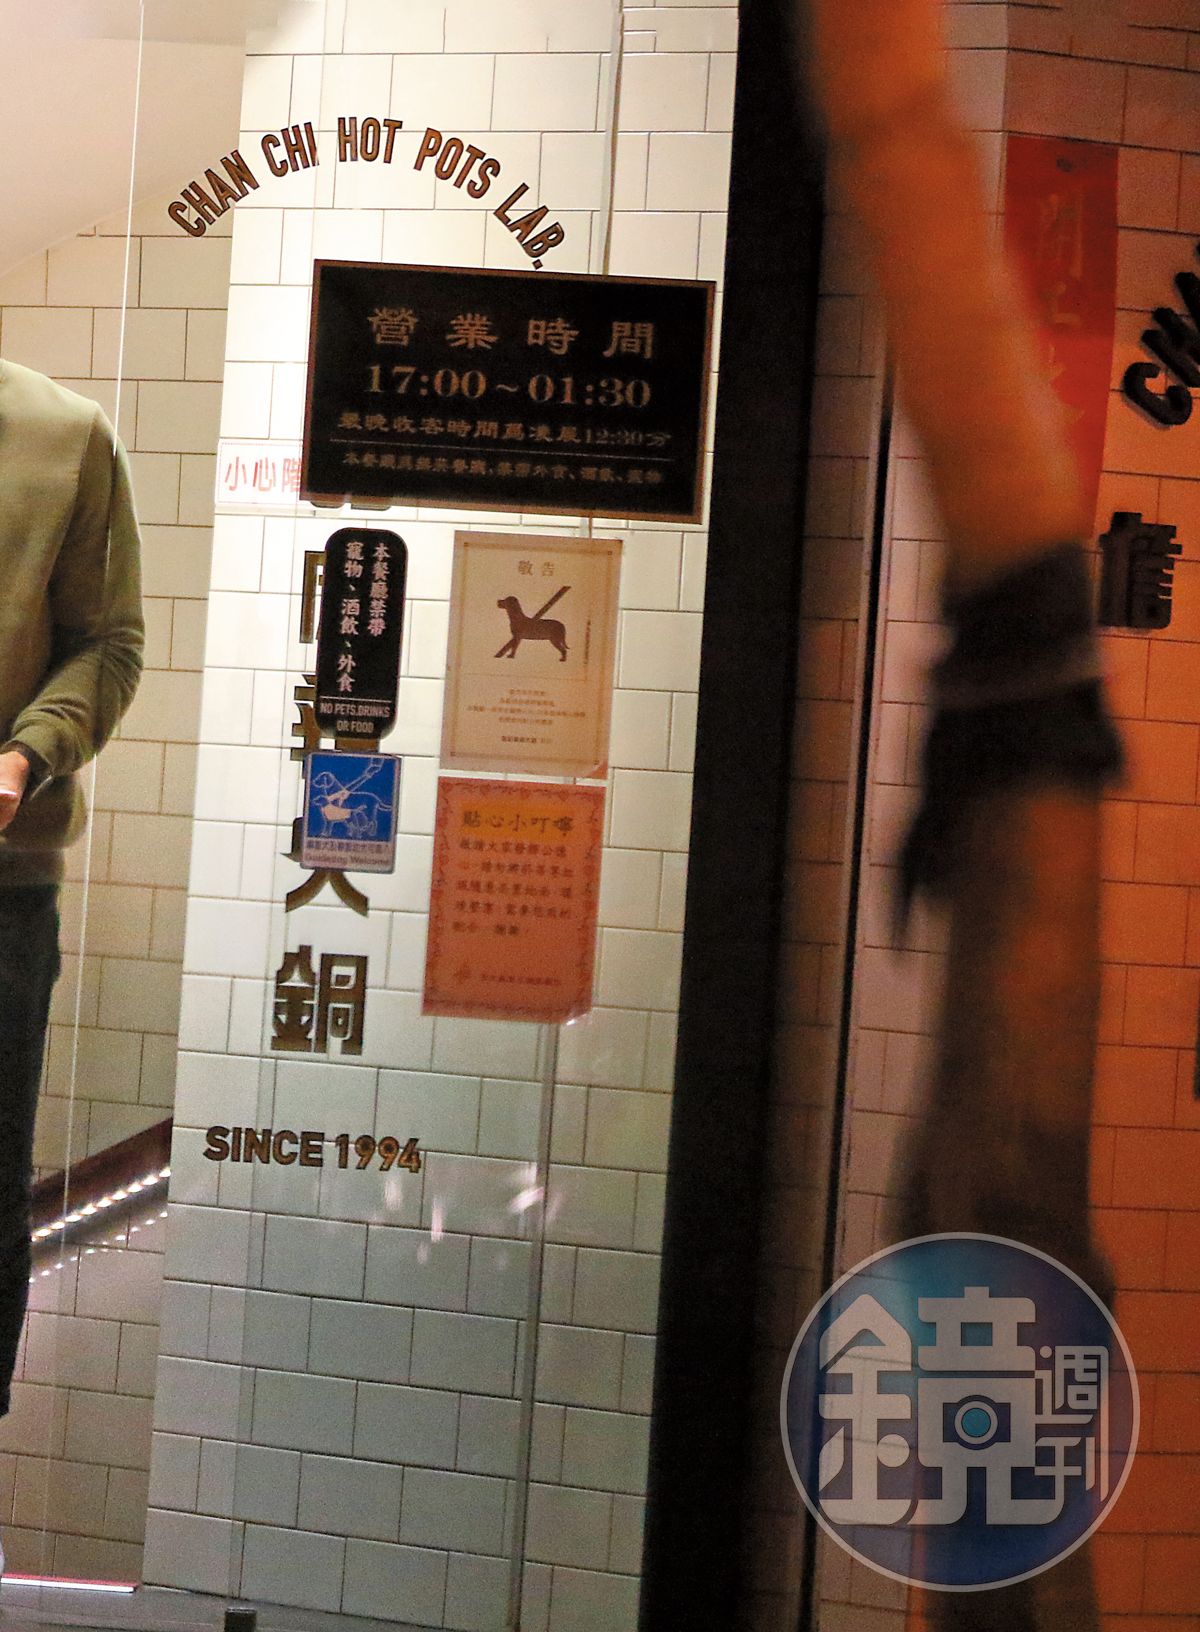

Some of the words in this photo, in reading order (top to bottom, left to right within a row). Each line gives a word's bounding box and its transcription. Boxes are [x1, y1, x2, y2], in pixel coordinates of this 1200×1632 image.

[168, 149, 259, 237] CHAN
[261, 121, 320, 178] CHI
[337, 116, 403, 164] HOT
[413, 127, 501, 199] POTS
[493, 182, 565, 270] LAB.
[368, 307, 655, 360] 營業時間
[320, 702, 333, 714] NO
[336, 720, 349, 732] OR
[351, 720, 375, 733] FOOD
[203, 1125, 325, 1168] SINCE
[336, 1133, 422, 1174] 1994
